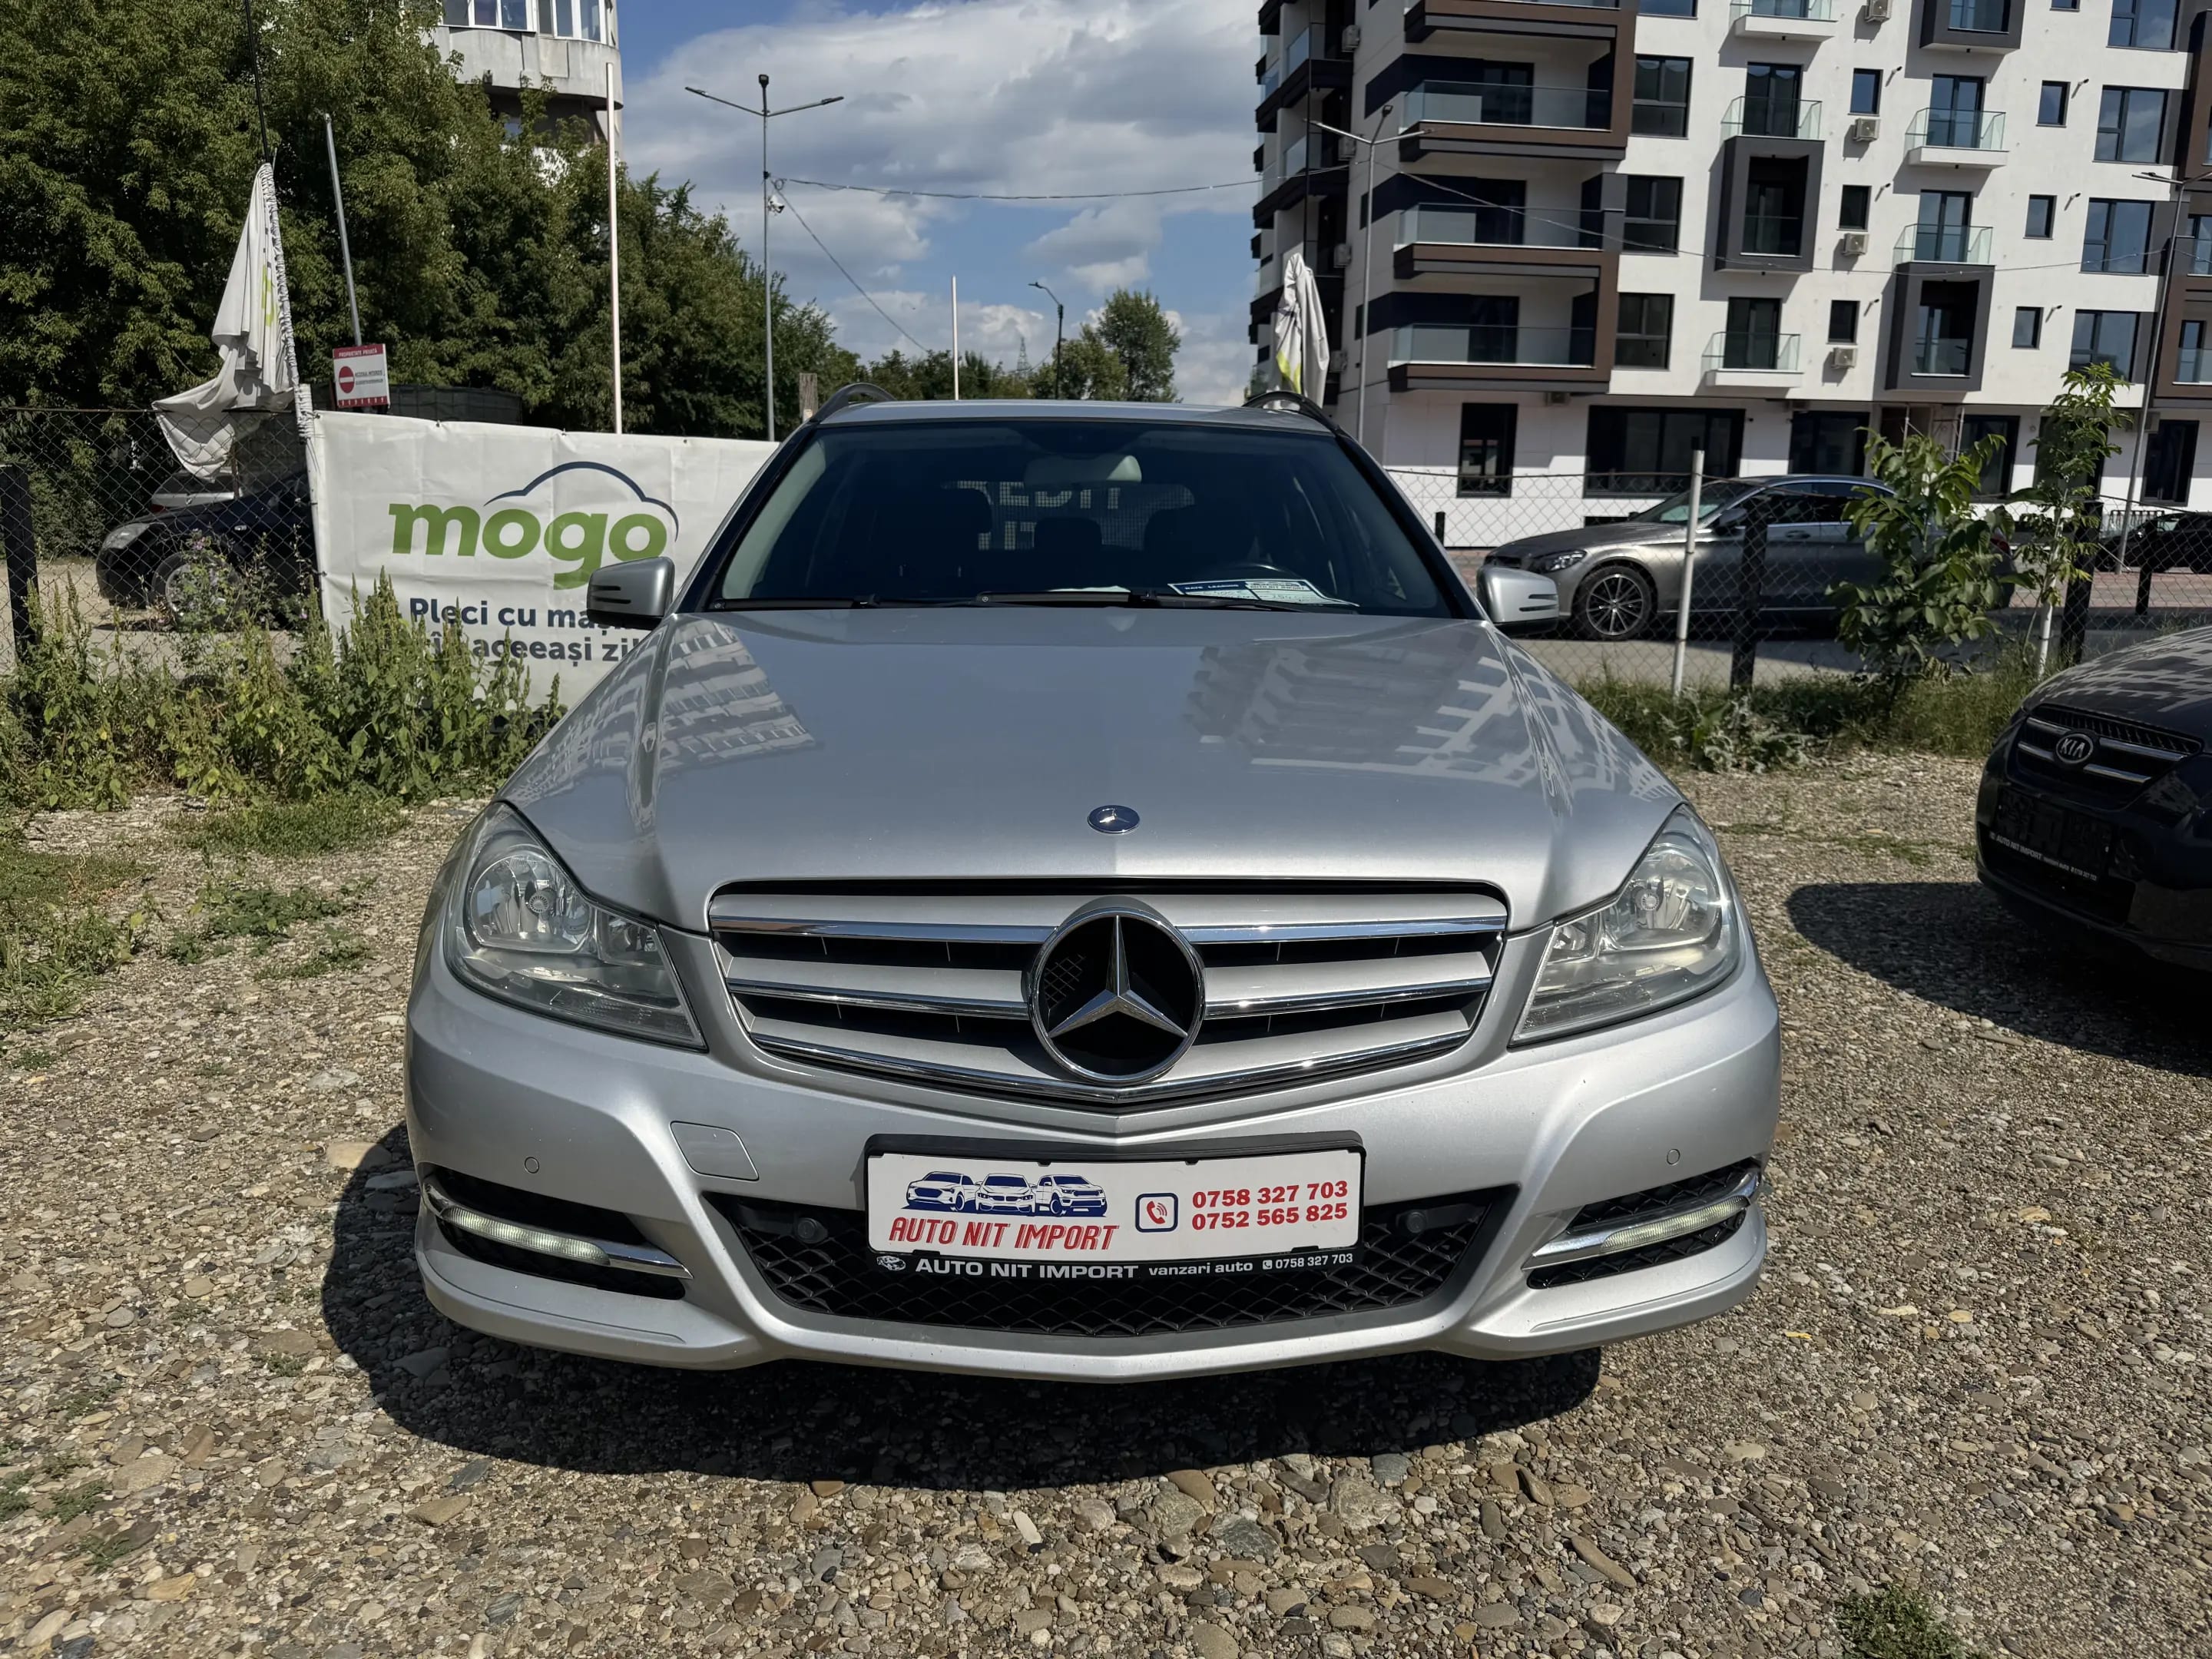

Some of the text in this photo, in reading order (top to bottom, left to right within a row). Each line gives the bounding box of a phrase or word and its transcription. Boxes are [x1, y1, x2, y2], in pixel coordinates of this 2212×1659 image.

[389, 503, 667, 590] mogo
[410, 598, 488, 624] Pleci
[498, 607, 536, 627] cu
[2059, 738, 2085, 758] KIA
[1192, 1181, 1348, 1208] 0758 327 703
[1191, 1203, 1348, 1230] 0752 565 825
[889, 1217, 1119, 1250] AUTO NIT IMPORT
[916, 1253, 1353, 1279] AUTO NIT IMPORT vanzari auto 0758 327 703
